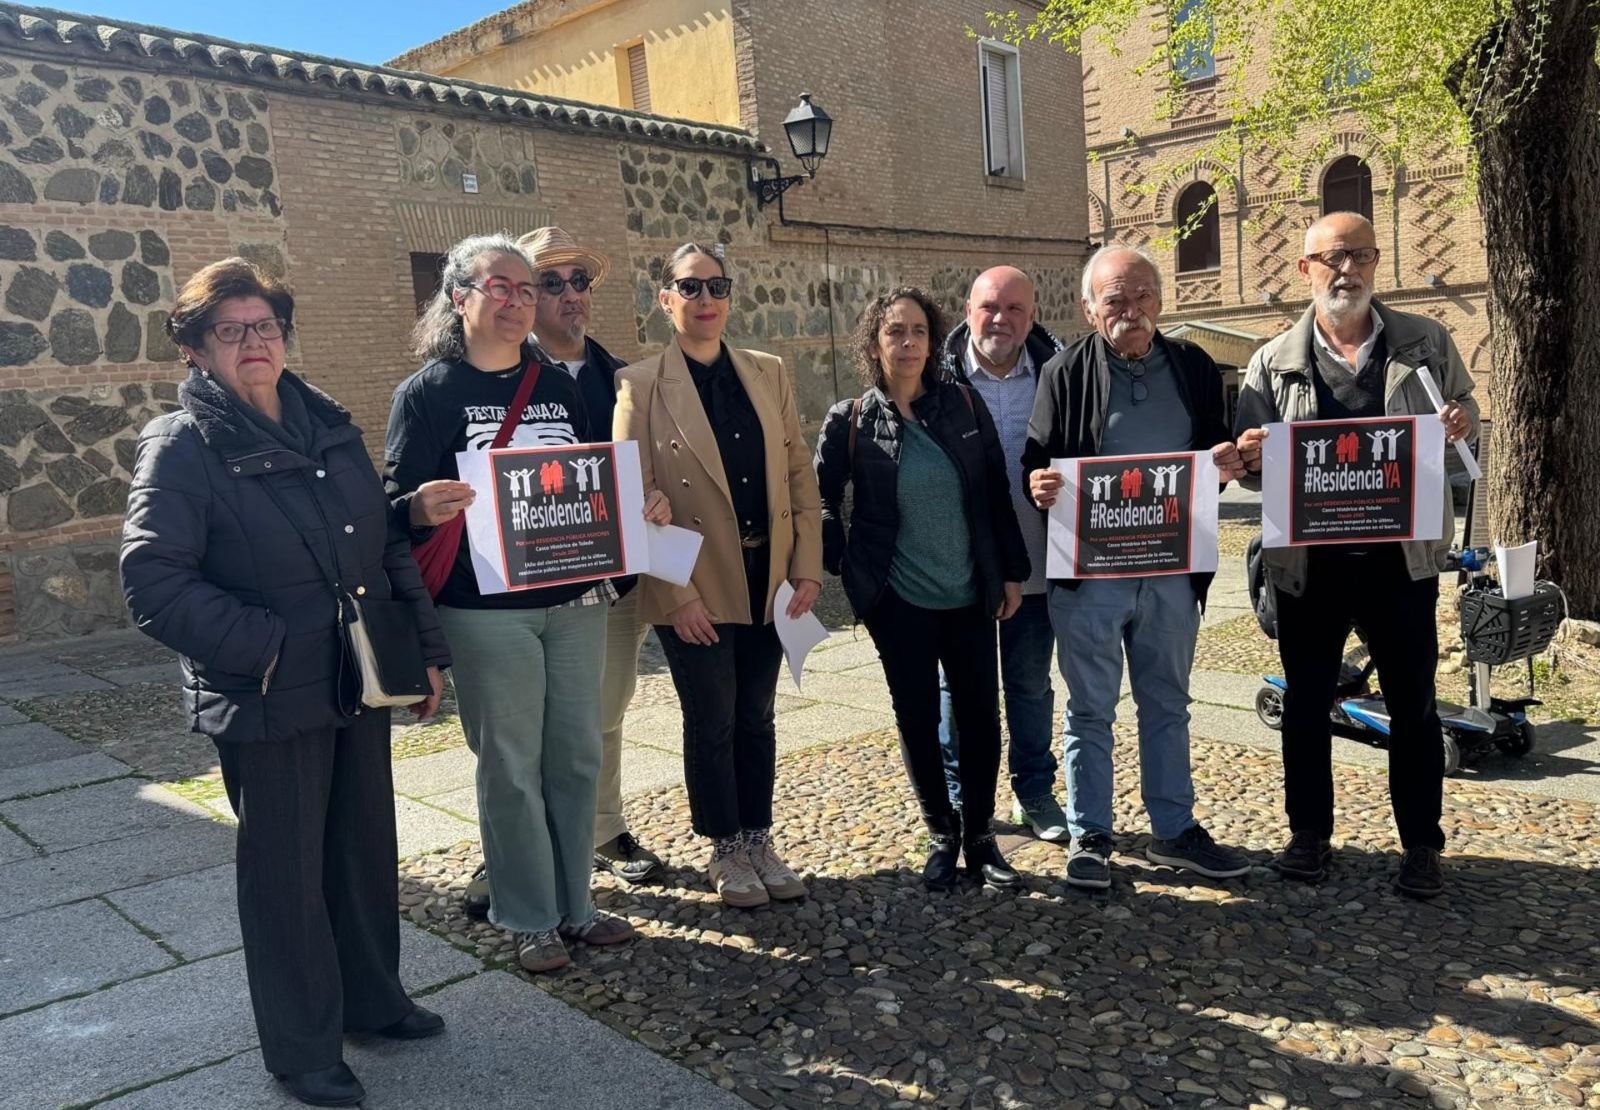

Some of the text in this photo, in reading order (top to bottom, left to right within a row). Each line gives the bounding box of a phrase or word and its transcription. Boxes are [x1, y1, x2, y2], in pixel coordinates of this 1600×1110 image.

[1304, 462, 1400, 493] #ResidenciaYA
[512, 492, 608, 530] #ResidenciaYA
[1090, 496, 1179, 528] #ResidenciaYA
[536, 536, 564, 544] RESIDENCIA
